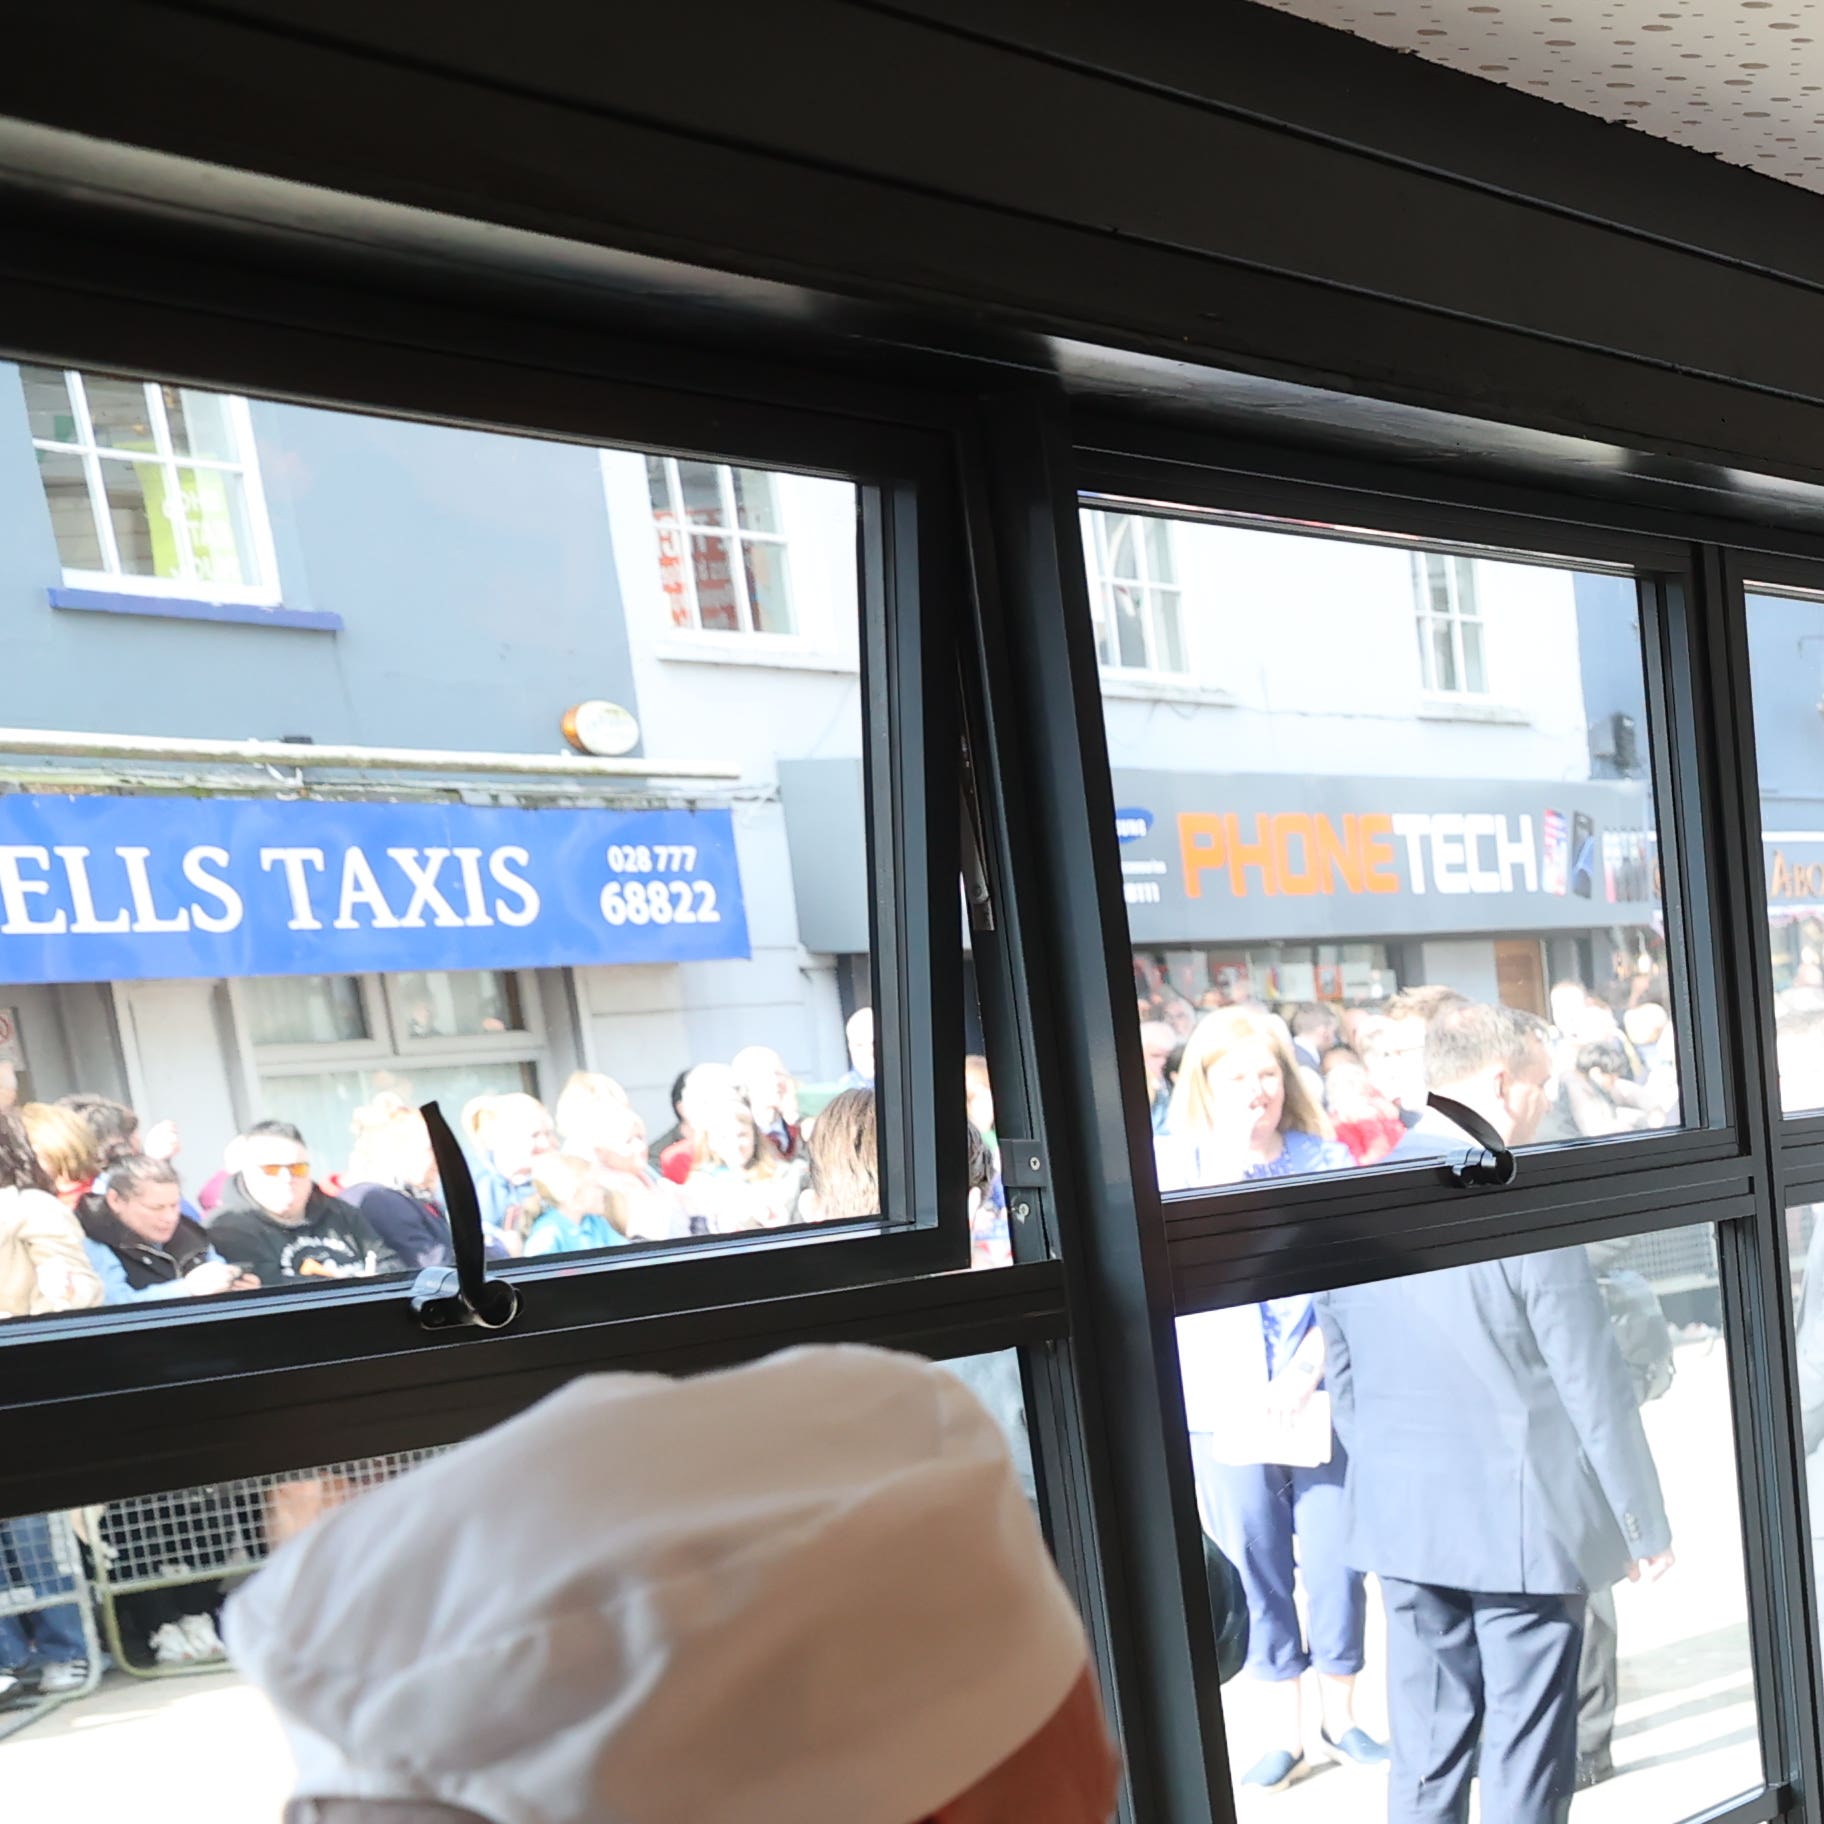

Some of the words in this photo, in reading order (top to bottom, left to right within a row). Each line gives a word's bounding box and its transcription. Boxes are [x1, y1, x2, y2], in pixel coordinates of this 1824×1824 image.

[607, 845, 652, 872] 028
[652, 845, 697, 872] 777
[260, 845, 540, 930] TAXIS
[600, 880, 720, 926] 68822
